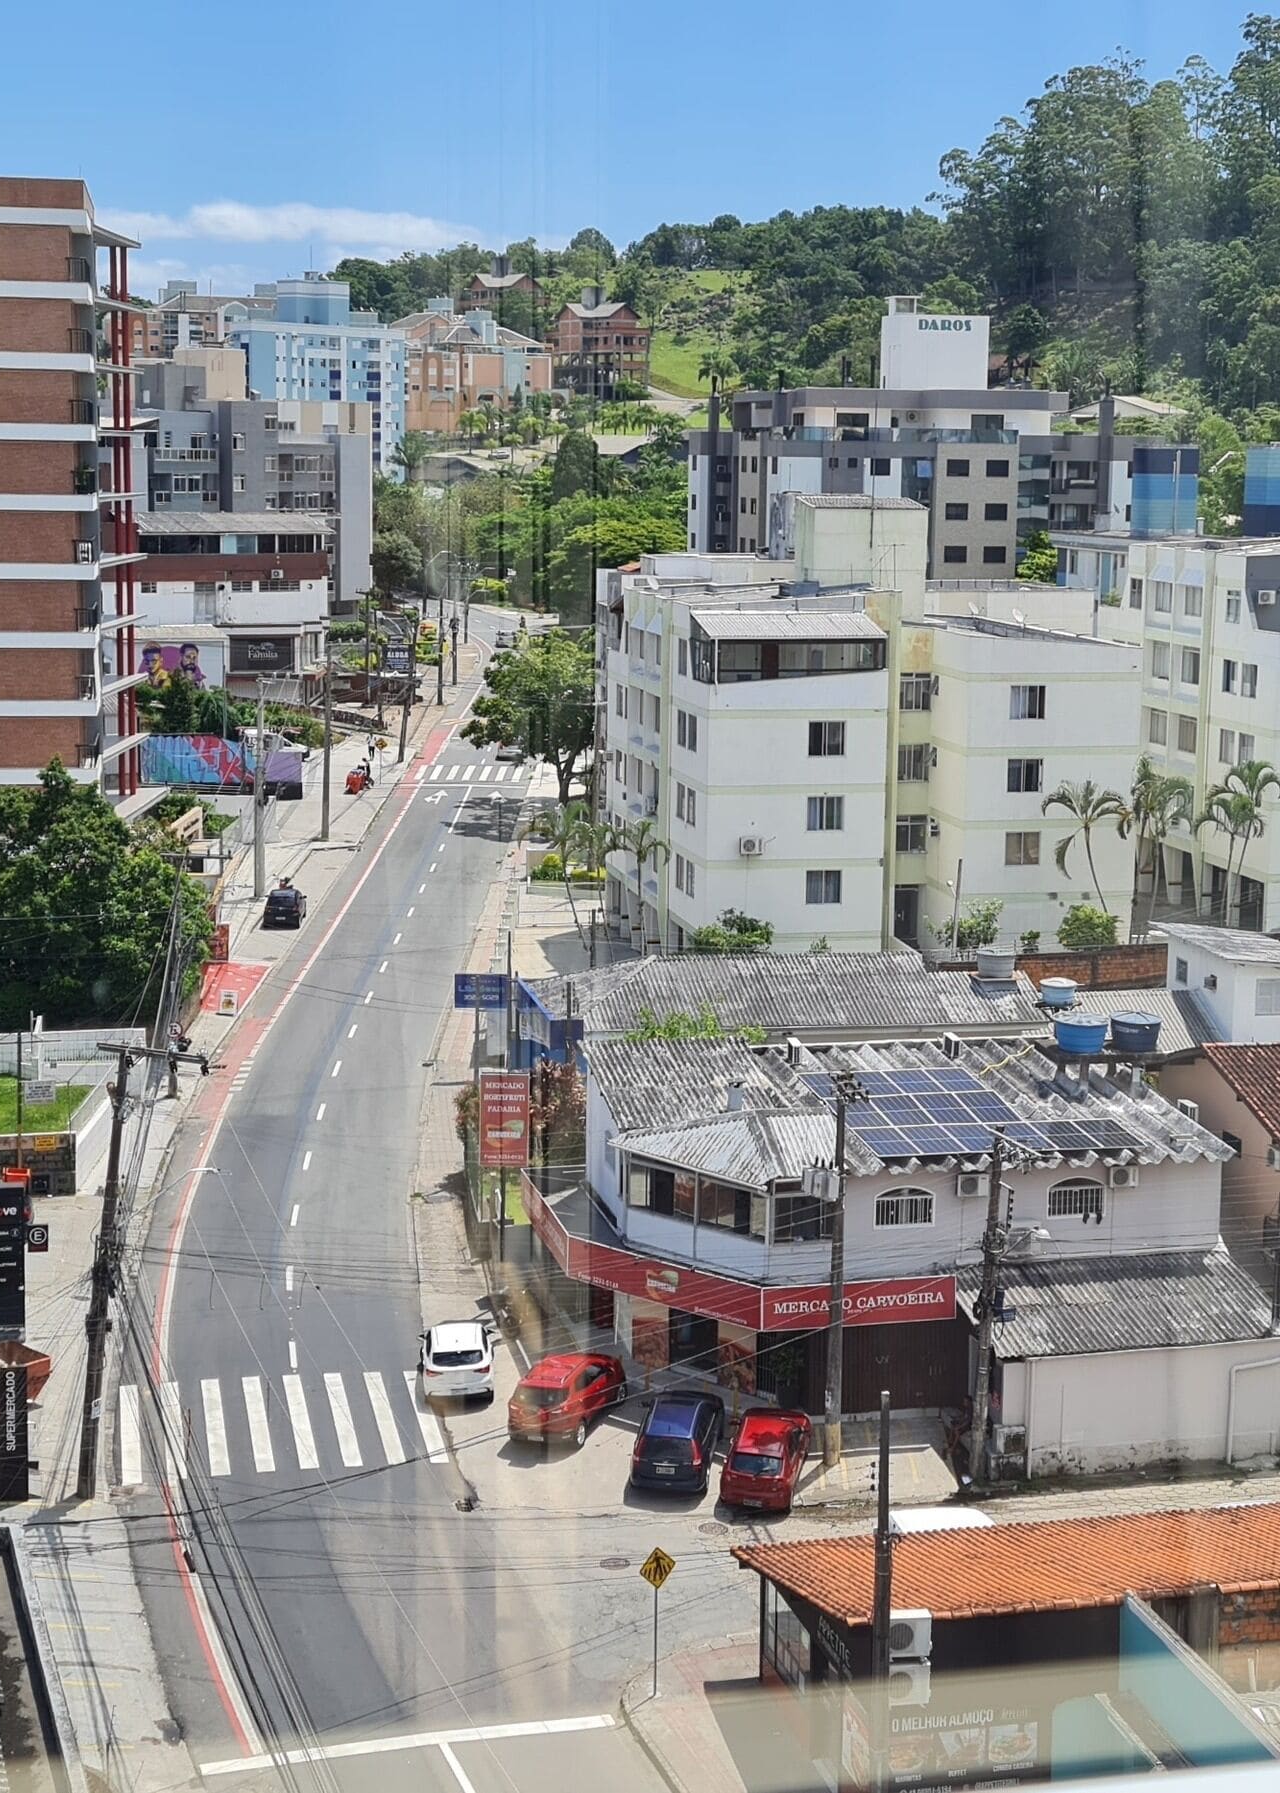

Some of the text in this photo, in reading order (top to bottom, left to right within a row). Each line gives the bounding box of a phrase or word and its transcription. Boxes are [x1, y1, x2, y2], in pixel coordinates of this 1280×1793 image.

[918, 318, 972, 332] DAROS
[485, 1082, 525, 1090] MERCADO
[487, 1105, 522, 1113] PADARIA
[33, 1230, 42, 1241] E
[773, 1291, 945, 1314] MERCAO CARVOEIRA
[6, 1371, 16, 1451] SUPERMERCADO
[948, 1708, 994, 1727] ALMOÇO
